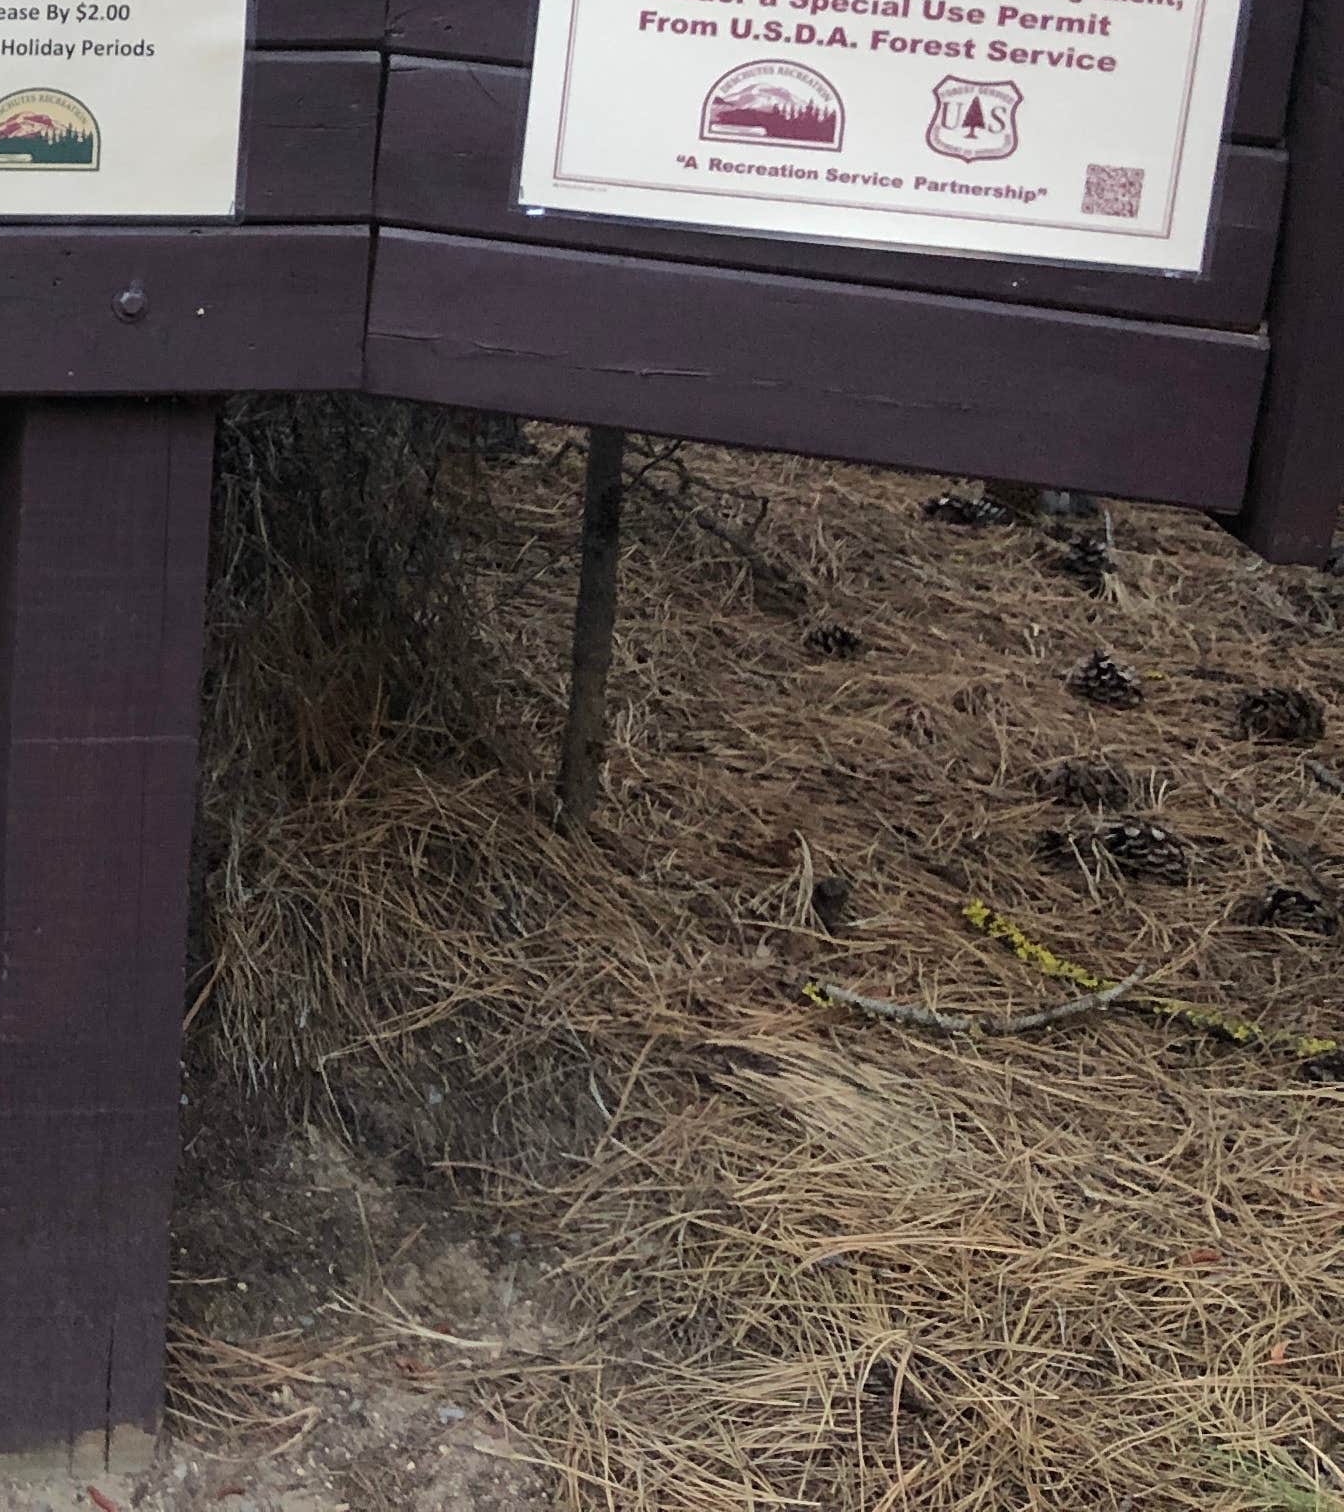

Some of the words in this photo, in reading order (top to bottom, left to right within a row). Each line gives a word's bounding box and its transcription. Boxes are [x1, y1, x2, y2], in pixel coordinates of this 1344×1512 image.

[46, 4, 71, 25] By
[75, 1, 131, 24] $2.00
[708, 157, 819, 181] Recreation
[825, 167, 904, 189] Service
